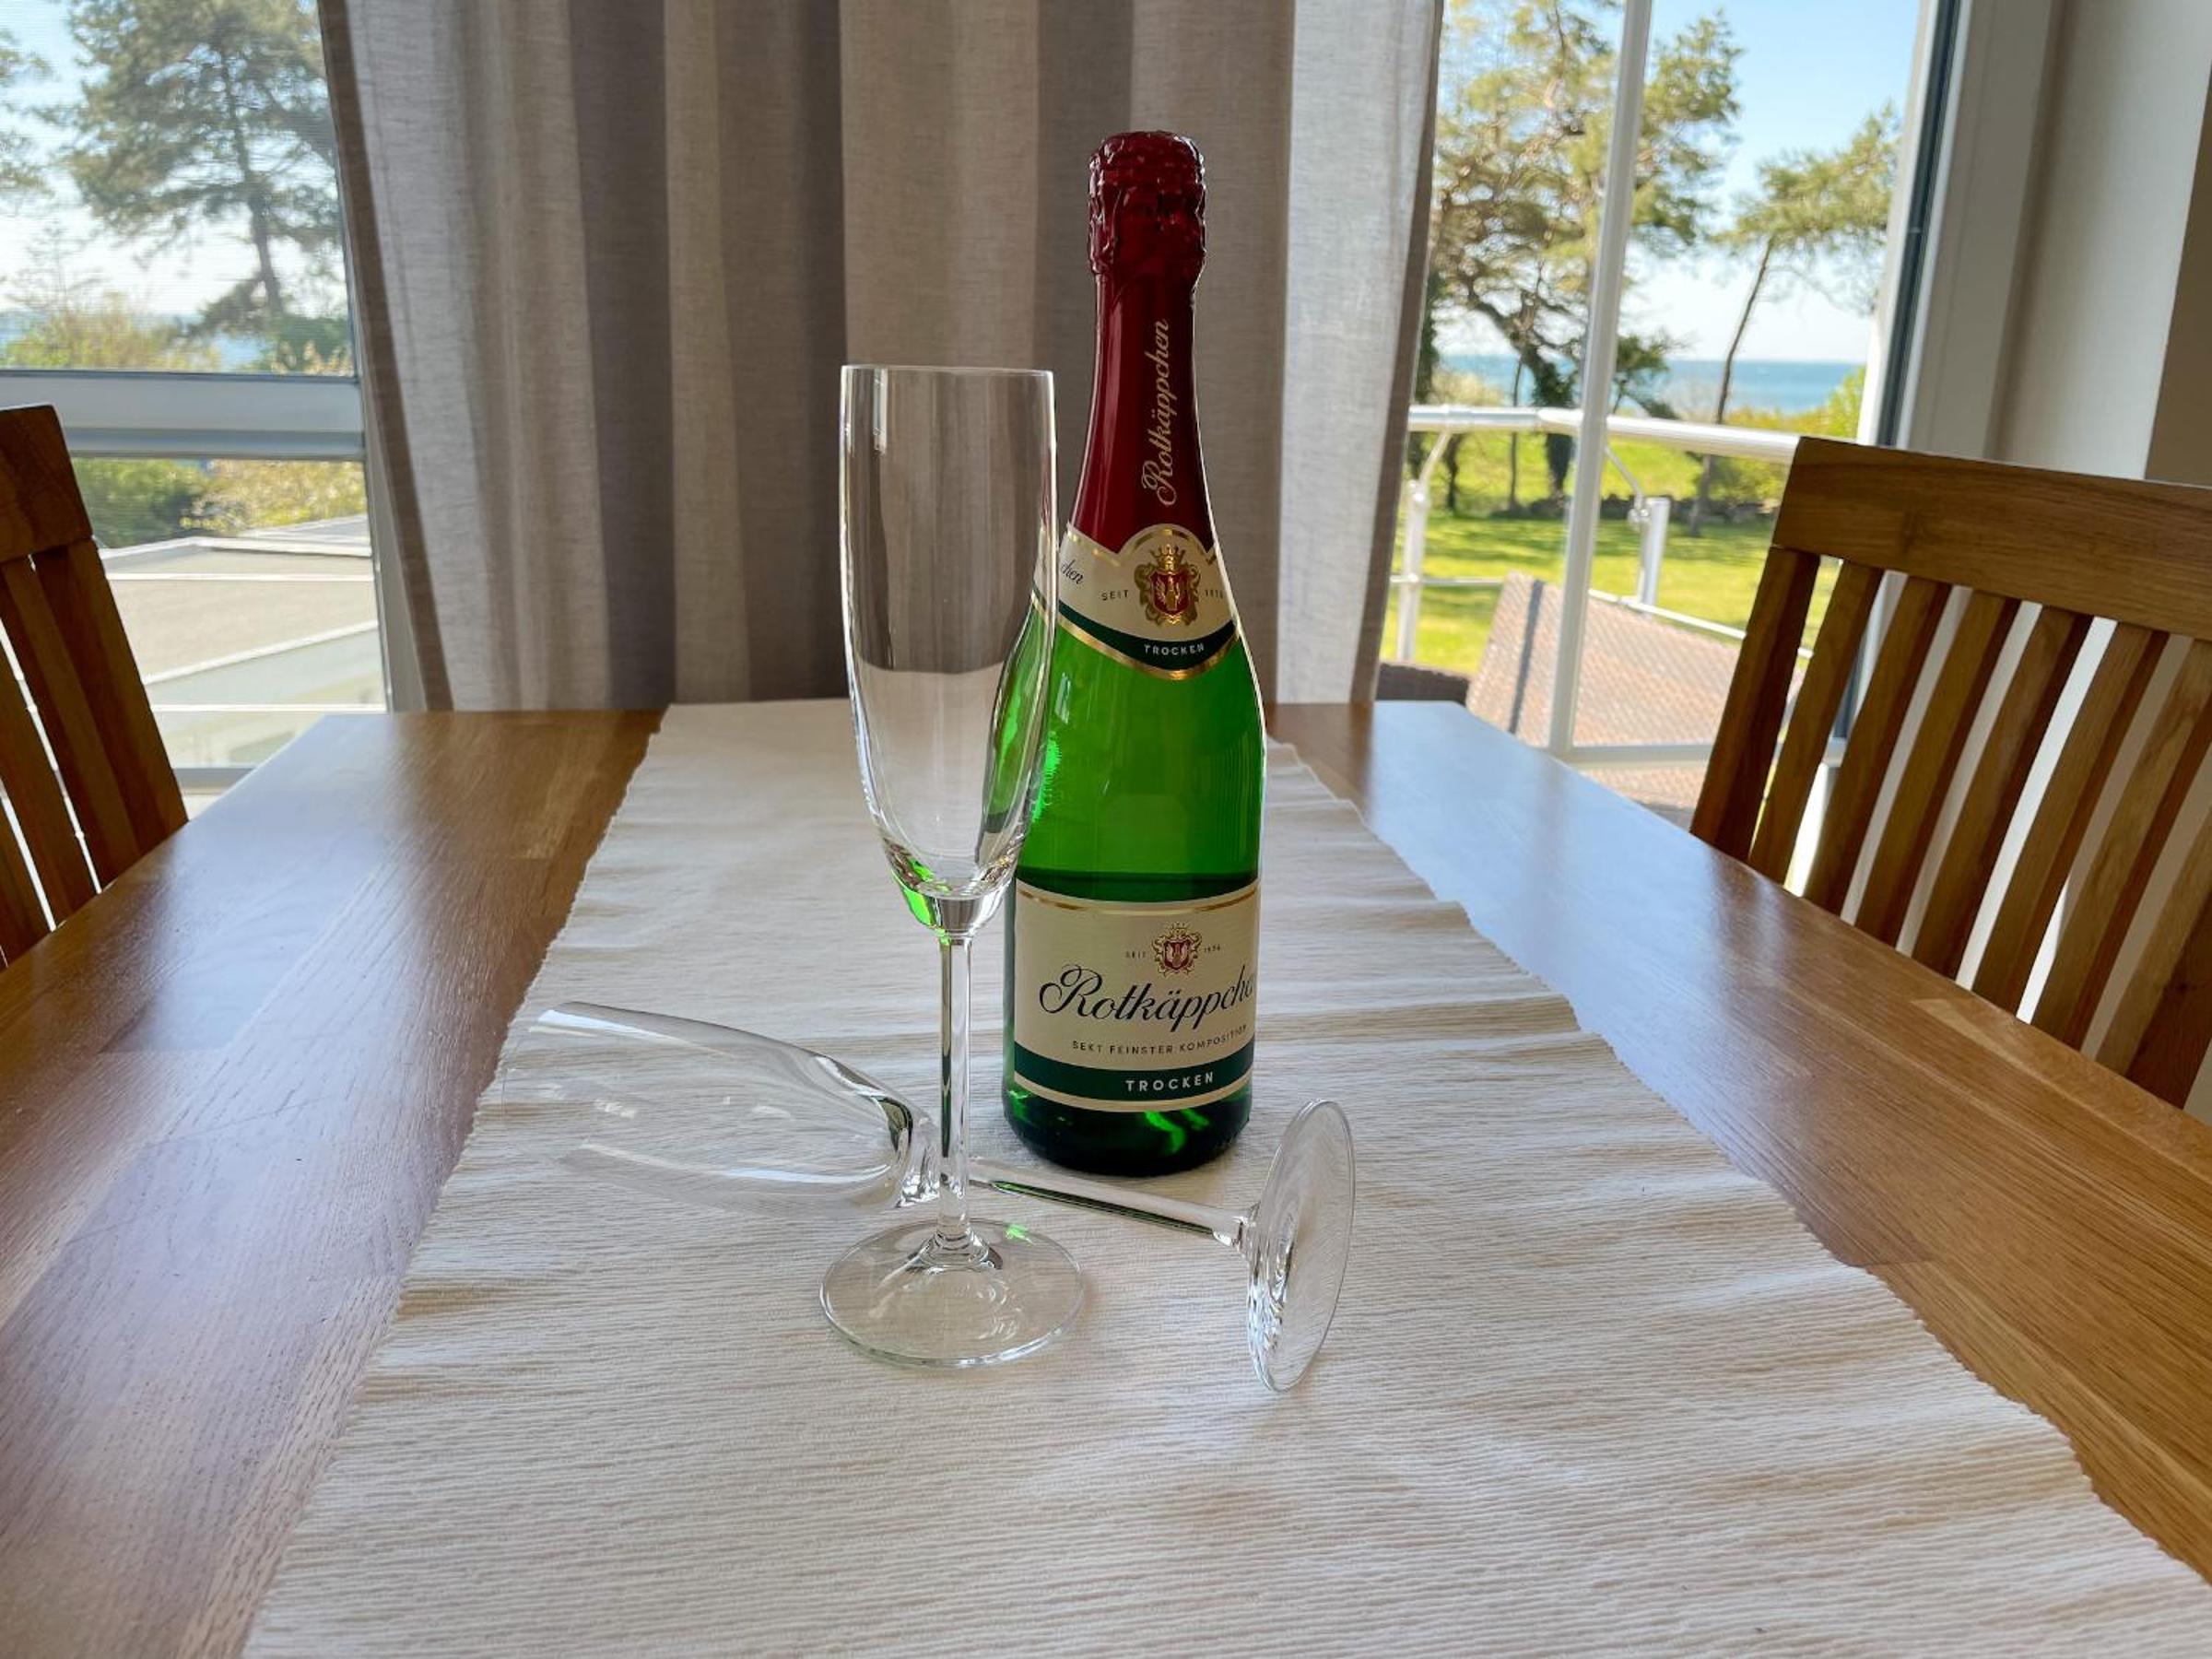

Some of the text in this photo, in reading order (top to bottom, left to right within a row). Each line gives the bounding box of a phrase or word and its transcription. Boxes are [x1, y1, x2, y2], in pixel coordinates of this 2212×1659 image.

[1141, 318, 1178, 507] Rotkäppchen
[1100, 589, 1129, 601] SEIT
[1144, 644, 1205, 656] TROCKEN
[1039, 964, 1254, 1032] Rotkäppche
[1072, 1040, 1102, 1053] SEKT
[1110, 1044, 1173, 1055] FEINSTER
[1125, 1071, 1214, 1092] TROCKEN
